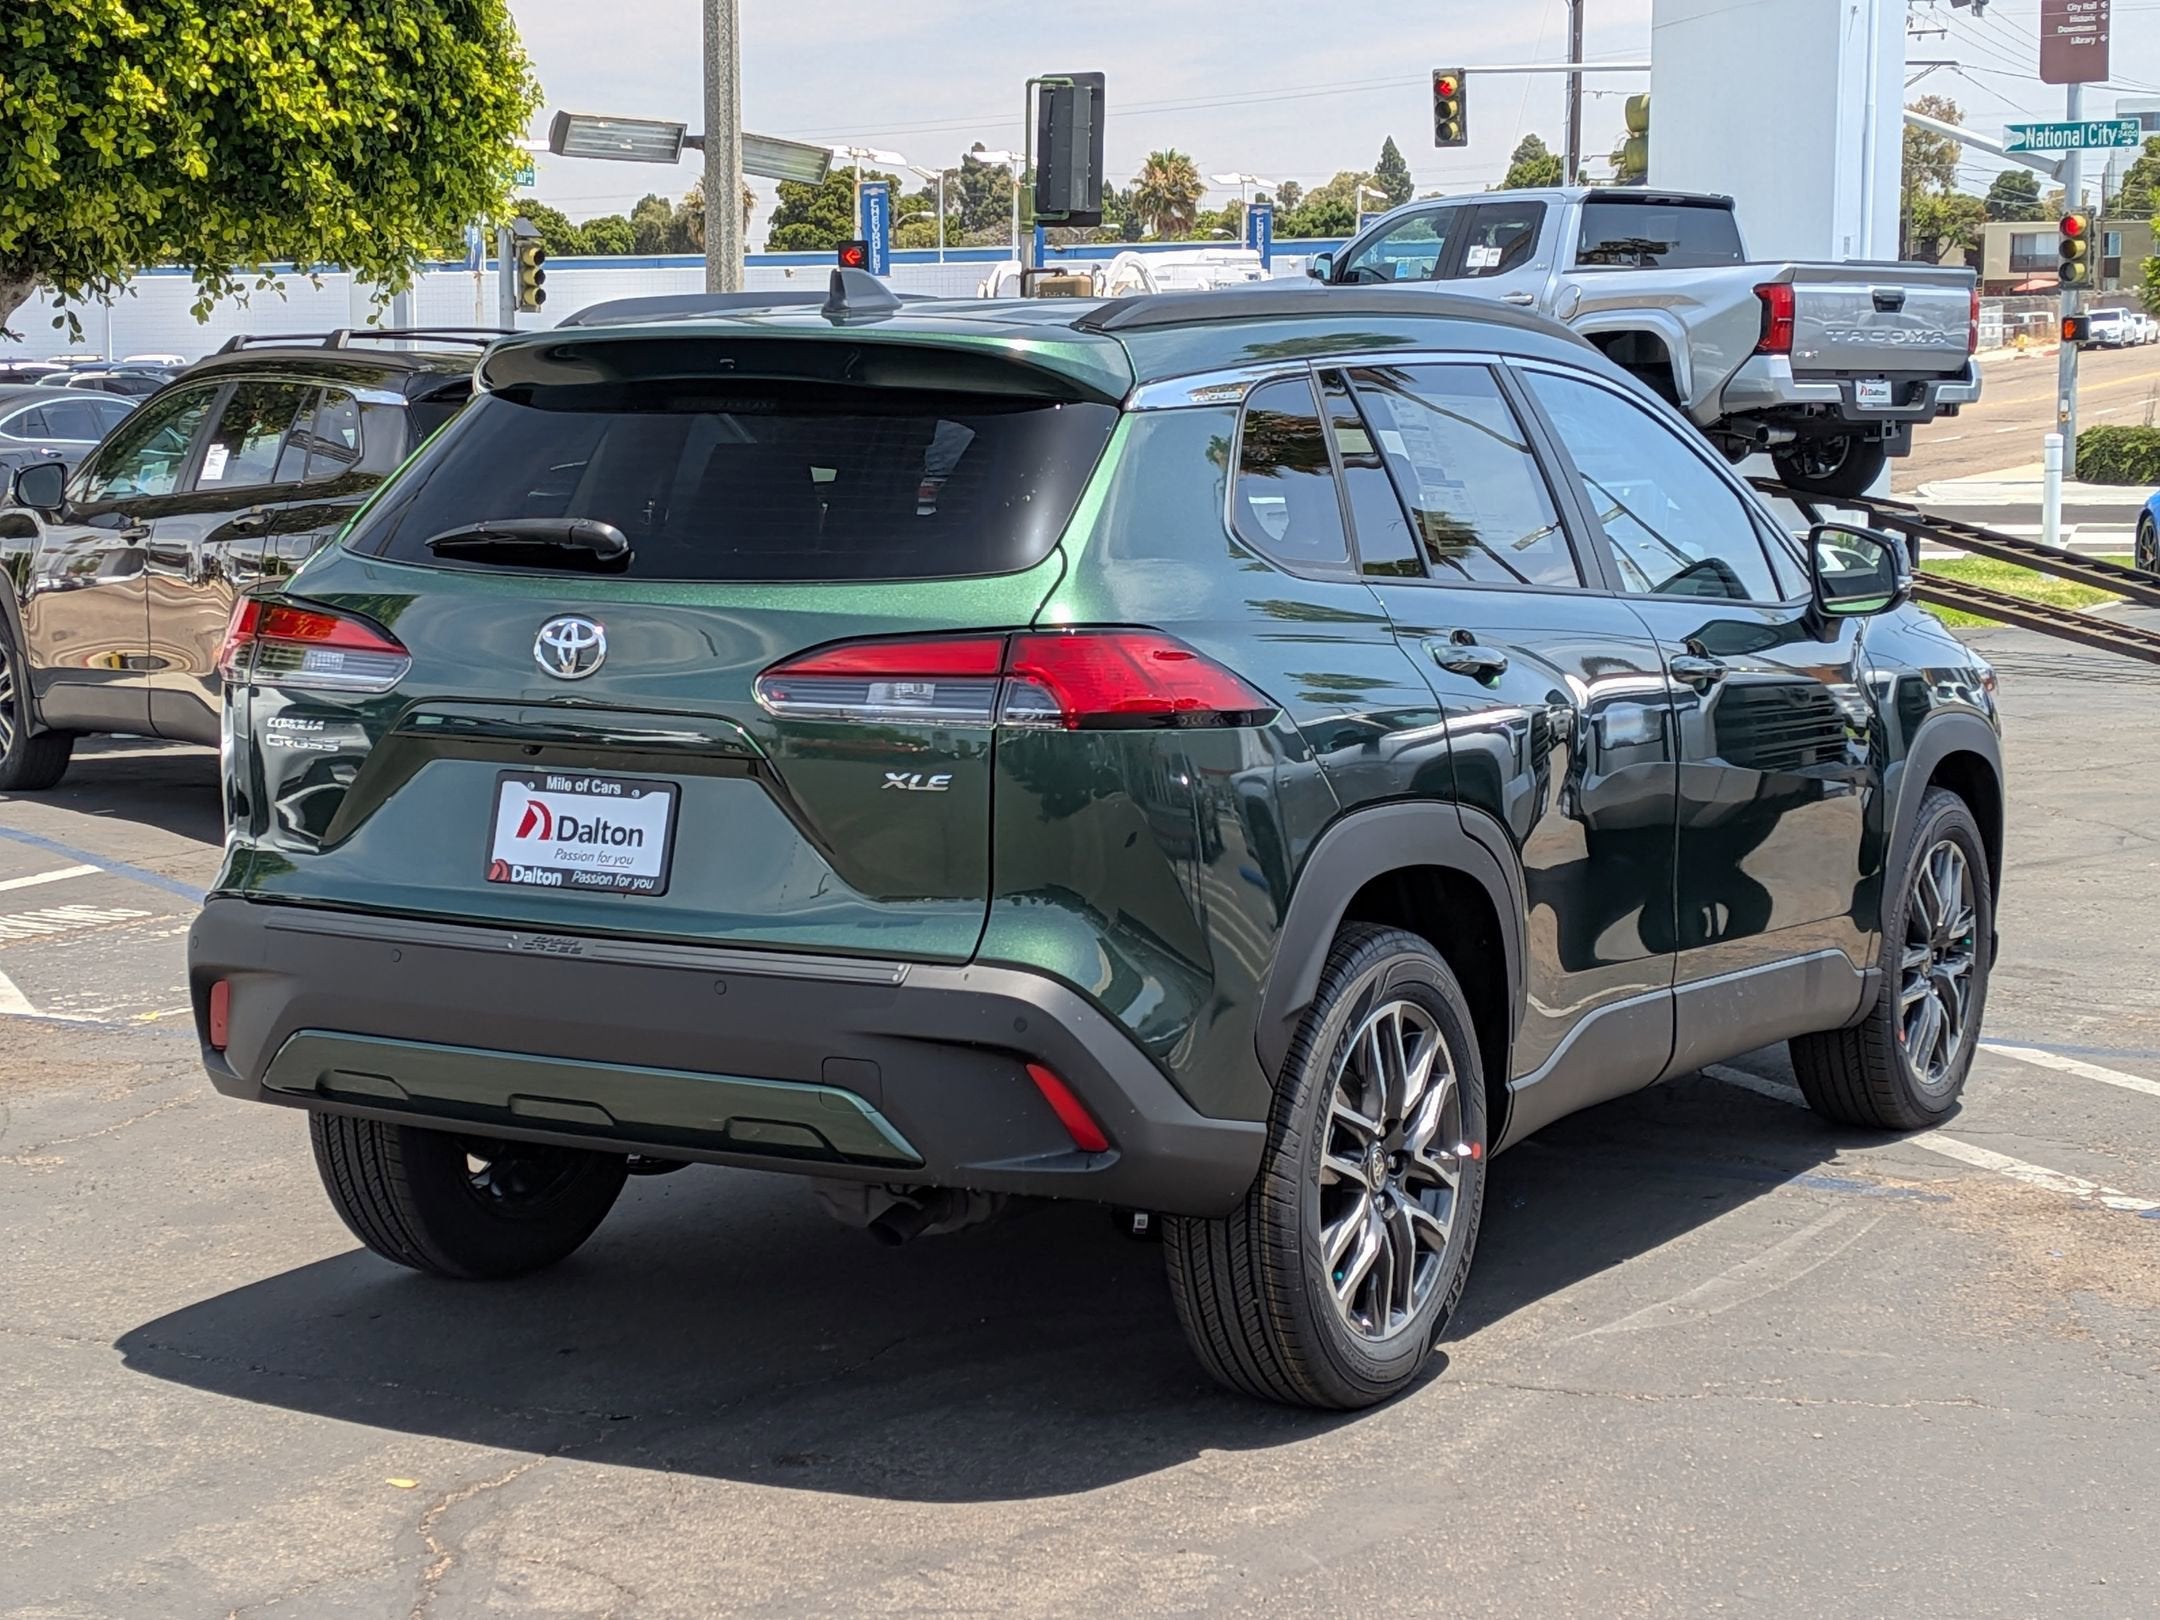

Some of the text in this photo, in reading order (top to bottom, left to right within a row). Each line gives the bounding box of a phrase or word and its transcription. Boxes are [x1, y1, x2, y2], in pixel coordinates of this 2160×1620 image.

[2071, 36, 2096, 45] Library
[2026, 124, 2084, 149] National
[2088, 123, 2117, 146] City
[870, 198, 881, 274] CHEVROLET
[1825, 329, 1946, 344] TACOMA
[266, 717, 325, 731] COROLLA
[265, 733, 340, 752] CROSS
[546, 775, 622, 795] Mile of Cars
[880, 772, 953, 791] XLE
[556, 815, 643, 848] Dalton
[554, 848, 634, 867] Passion for you
[511, 865, 655, 890] Dalton Passion for you
